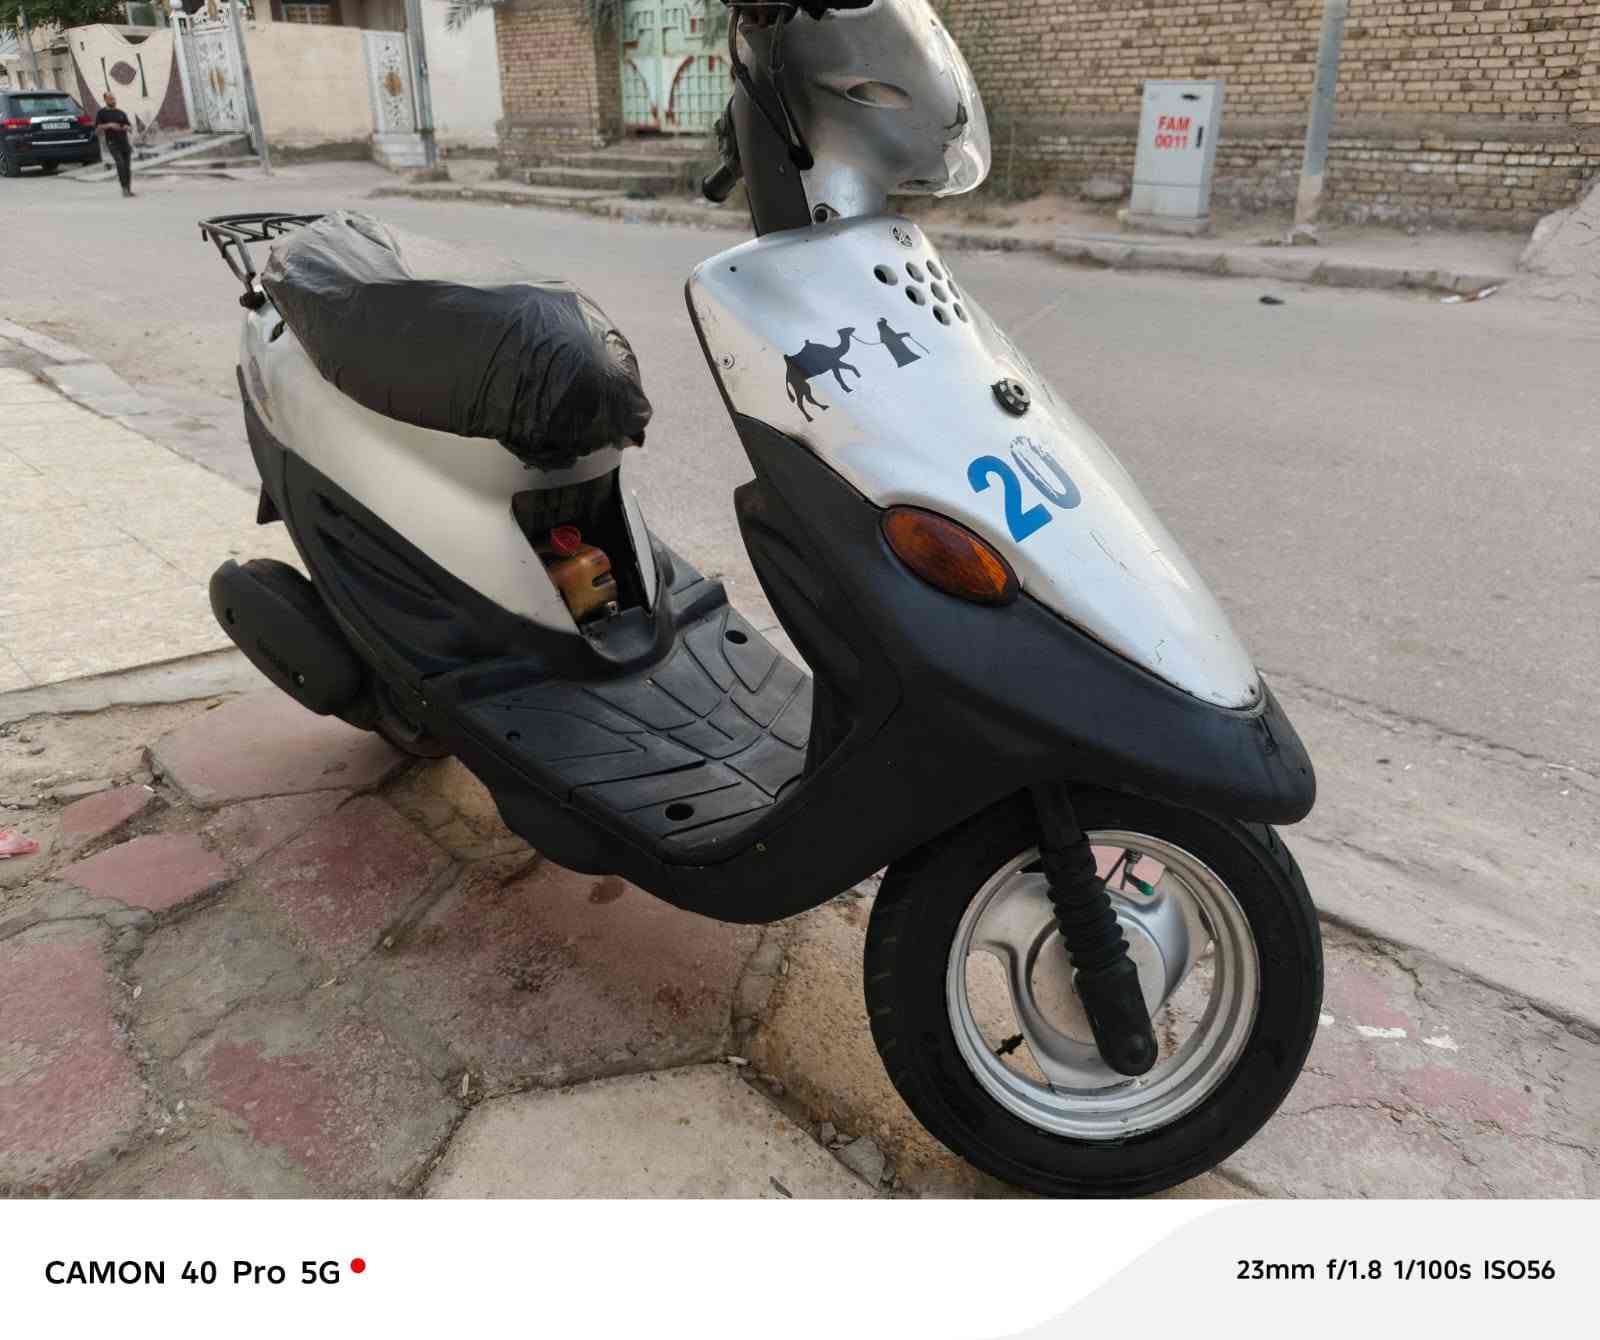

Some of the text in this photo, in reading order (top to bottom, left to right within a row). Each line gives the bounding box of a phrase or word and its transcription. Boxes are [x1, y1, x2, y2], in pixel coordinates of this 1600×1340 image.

[1158, 116, 1191, 130] FAM
[1155, 134, 1188, 149] 0011
[967, 435, 1081, 543] 20
